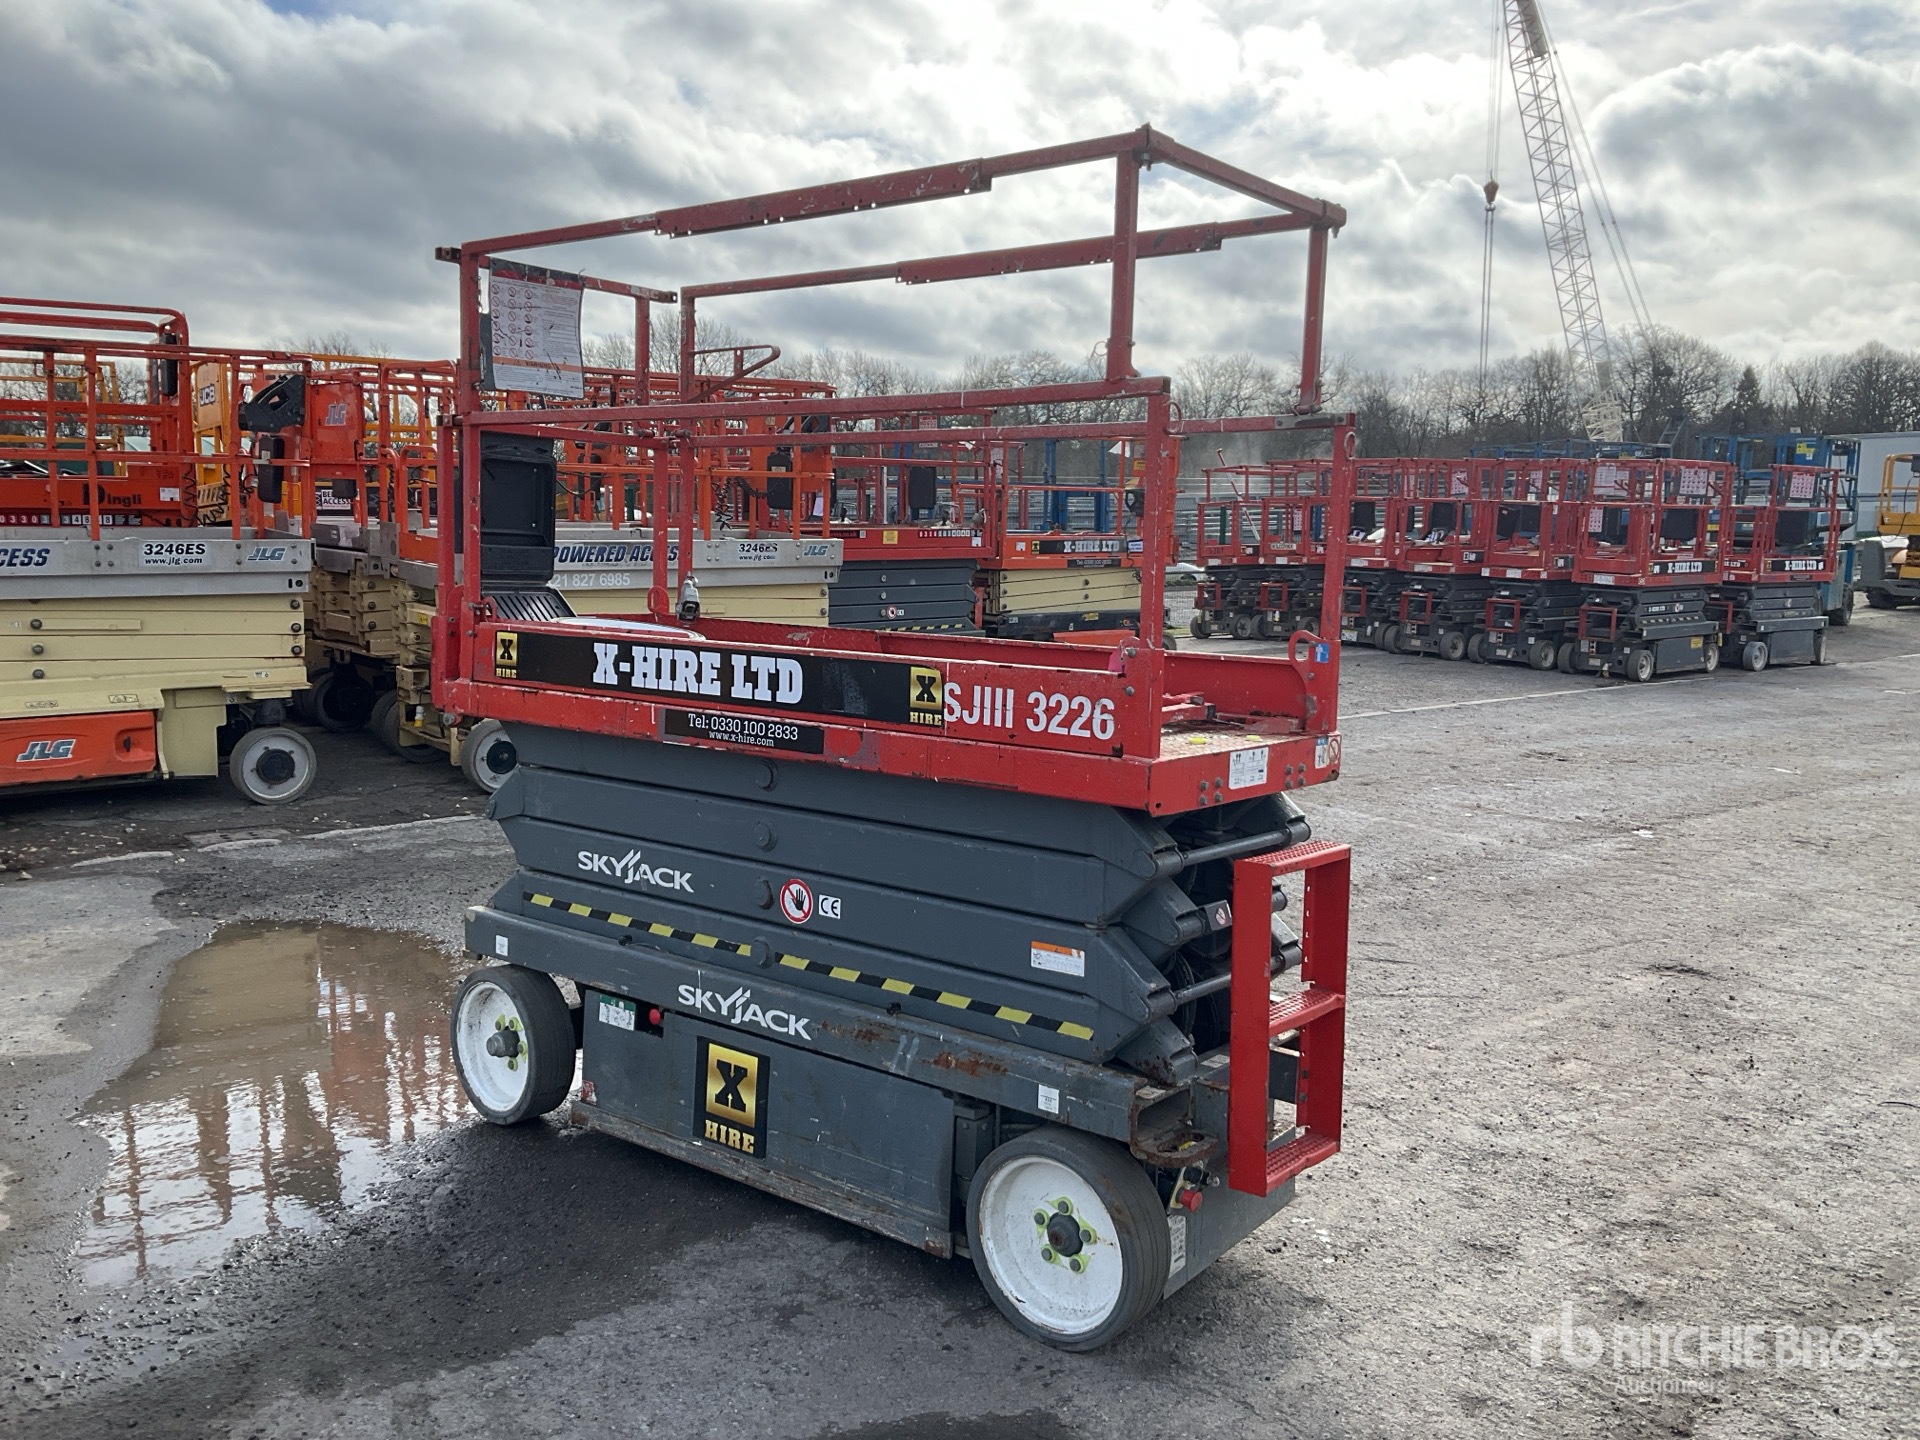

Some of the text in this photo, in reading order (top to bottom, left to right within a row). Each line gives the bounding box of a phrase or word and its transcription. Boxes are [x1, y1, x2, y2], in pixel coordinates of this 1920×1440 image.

[199, 385, 215, 405] JCB
[325, 403, 347, 426] JLG
[144, 543, 206, 555] 3246ES
[247, 547, 286, 561] JLG
[803, 545, 829, 556] JLG
[1063, 541, 1099, 553] X-HIRE
[1101, 540, 1120, 552] LTD
[145, 557, 203, 566] www.jlg.com
[572, 573, 595, 587] 827
[599, 572, 630, 586] 6985
[500, 639, 513, 660] X
[495, 668, 517, 679] HIRE
[592, 642, 803, 704] X-HIRE LTD
[915, 675, 937, 703] X
[910, 711, 942, 726] HIRE
[944, 683, 1115, 740] SJIII 3226
[688, 713, 798, 741] Tel: 0330 100 2833
[708, 730, 774, 747] www.x-hire.com
[16, 739, 77, 763] JLG
[577, 849, 695, 893] SKYJACK
[678, 984, 811, 1040] SKYJACK
[714, 1059, 748, 1113] X
[705, 1119, 755, 1154] HIRE
